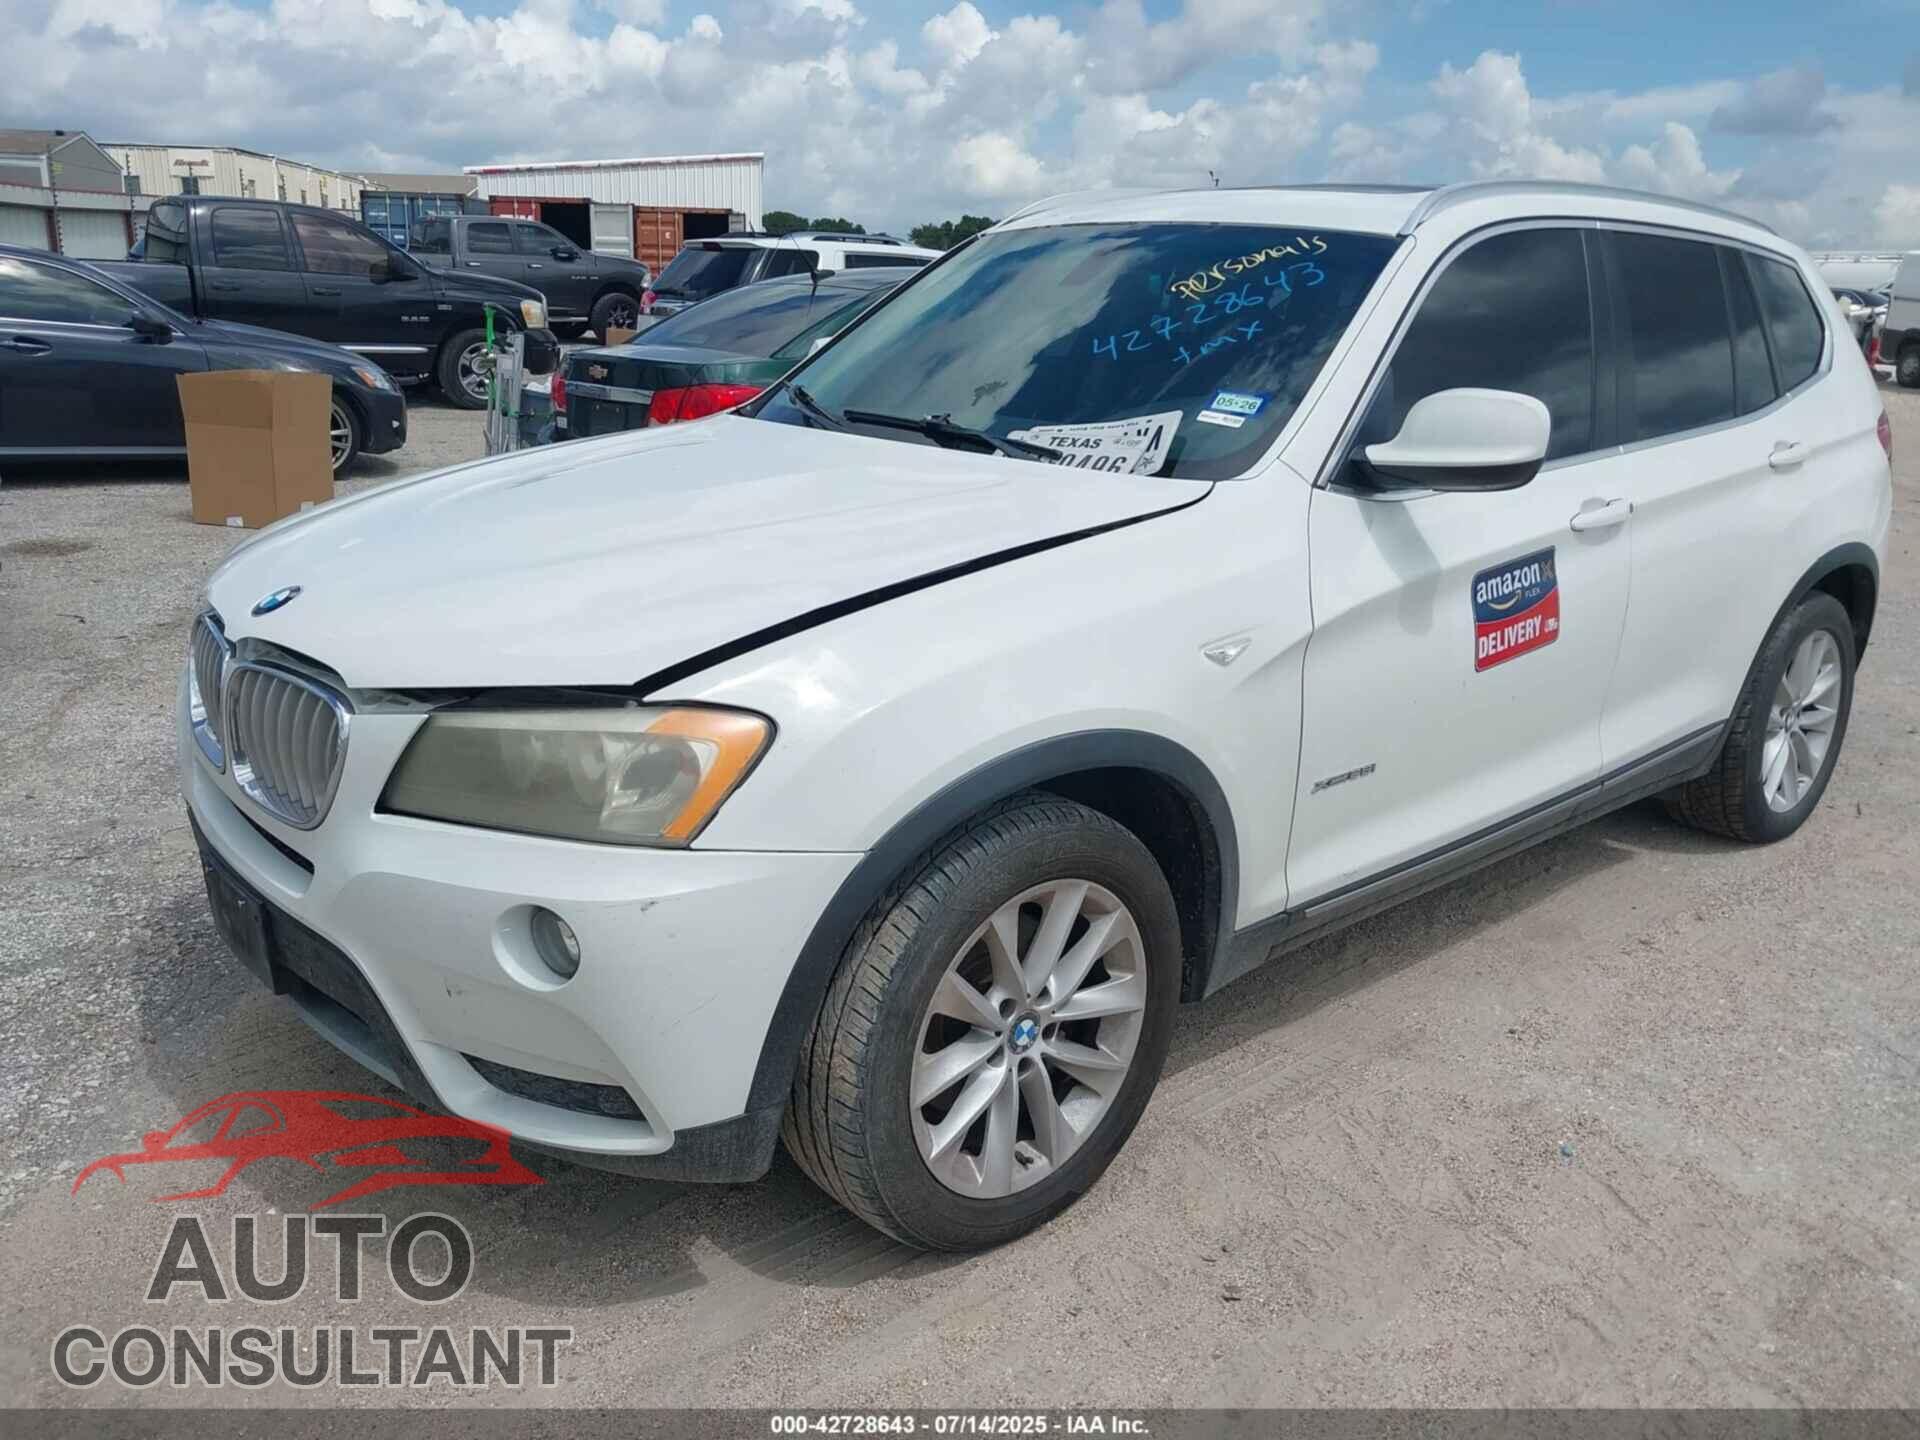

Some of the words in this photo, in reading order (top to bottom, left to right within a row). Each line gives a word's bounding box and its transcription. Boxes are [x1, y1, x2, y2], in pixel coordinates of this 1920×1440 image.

[1093, 261, 1325, 360] 42728643
[1049, 436, 1102, 449] TEXAS
[1476, 563, 1540, 604] amazon
[1478, 614, 1542, 659] DELIVERY
